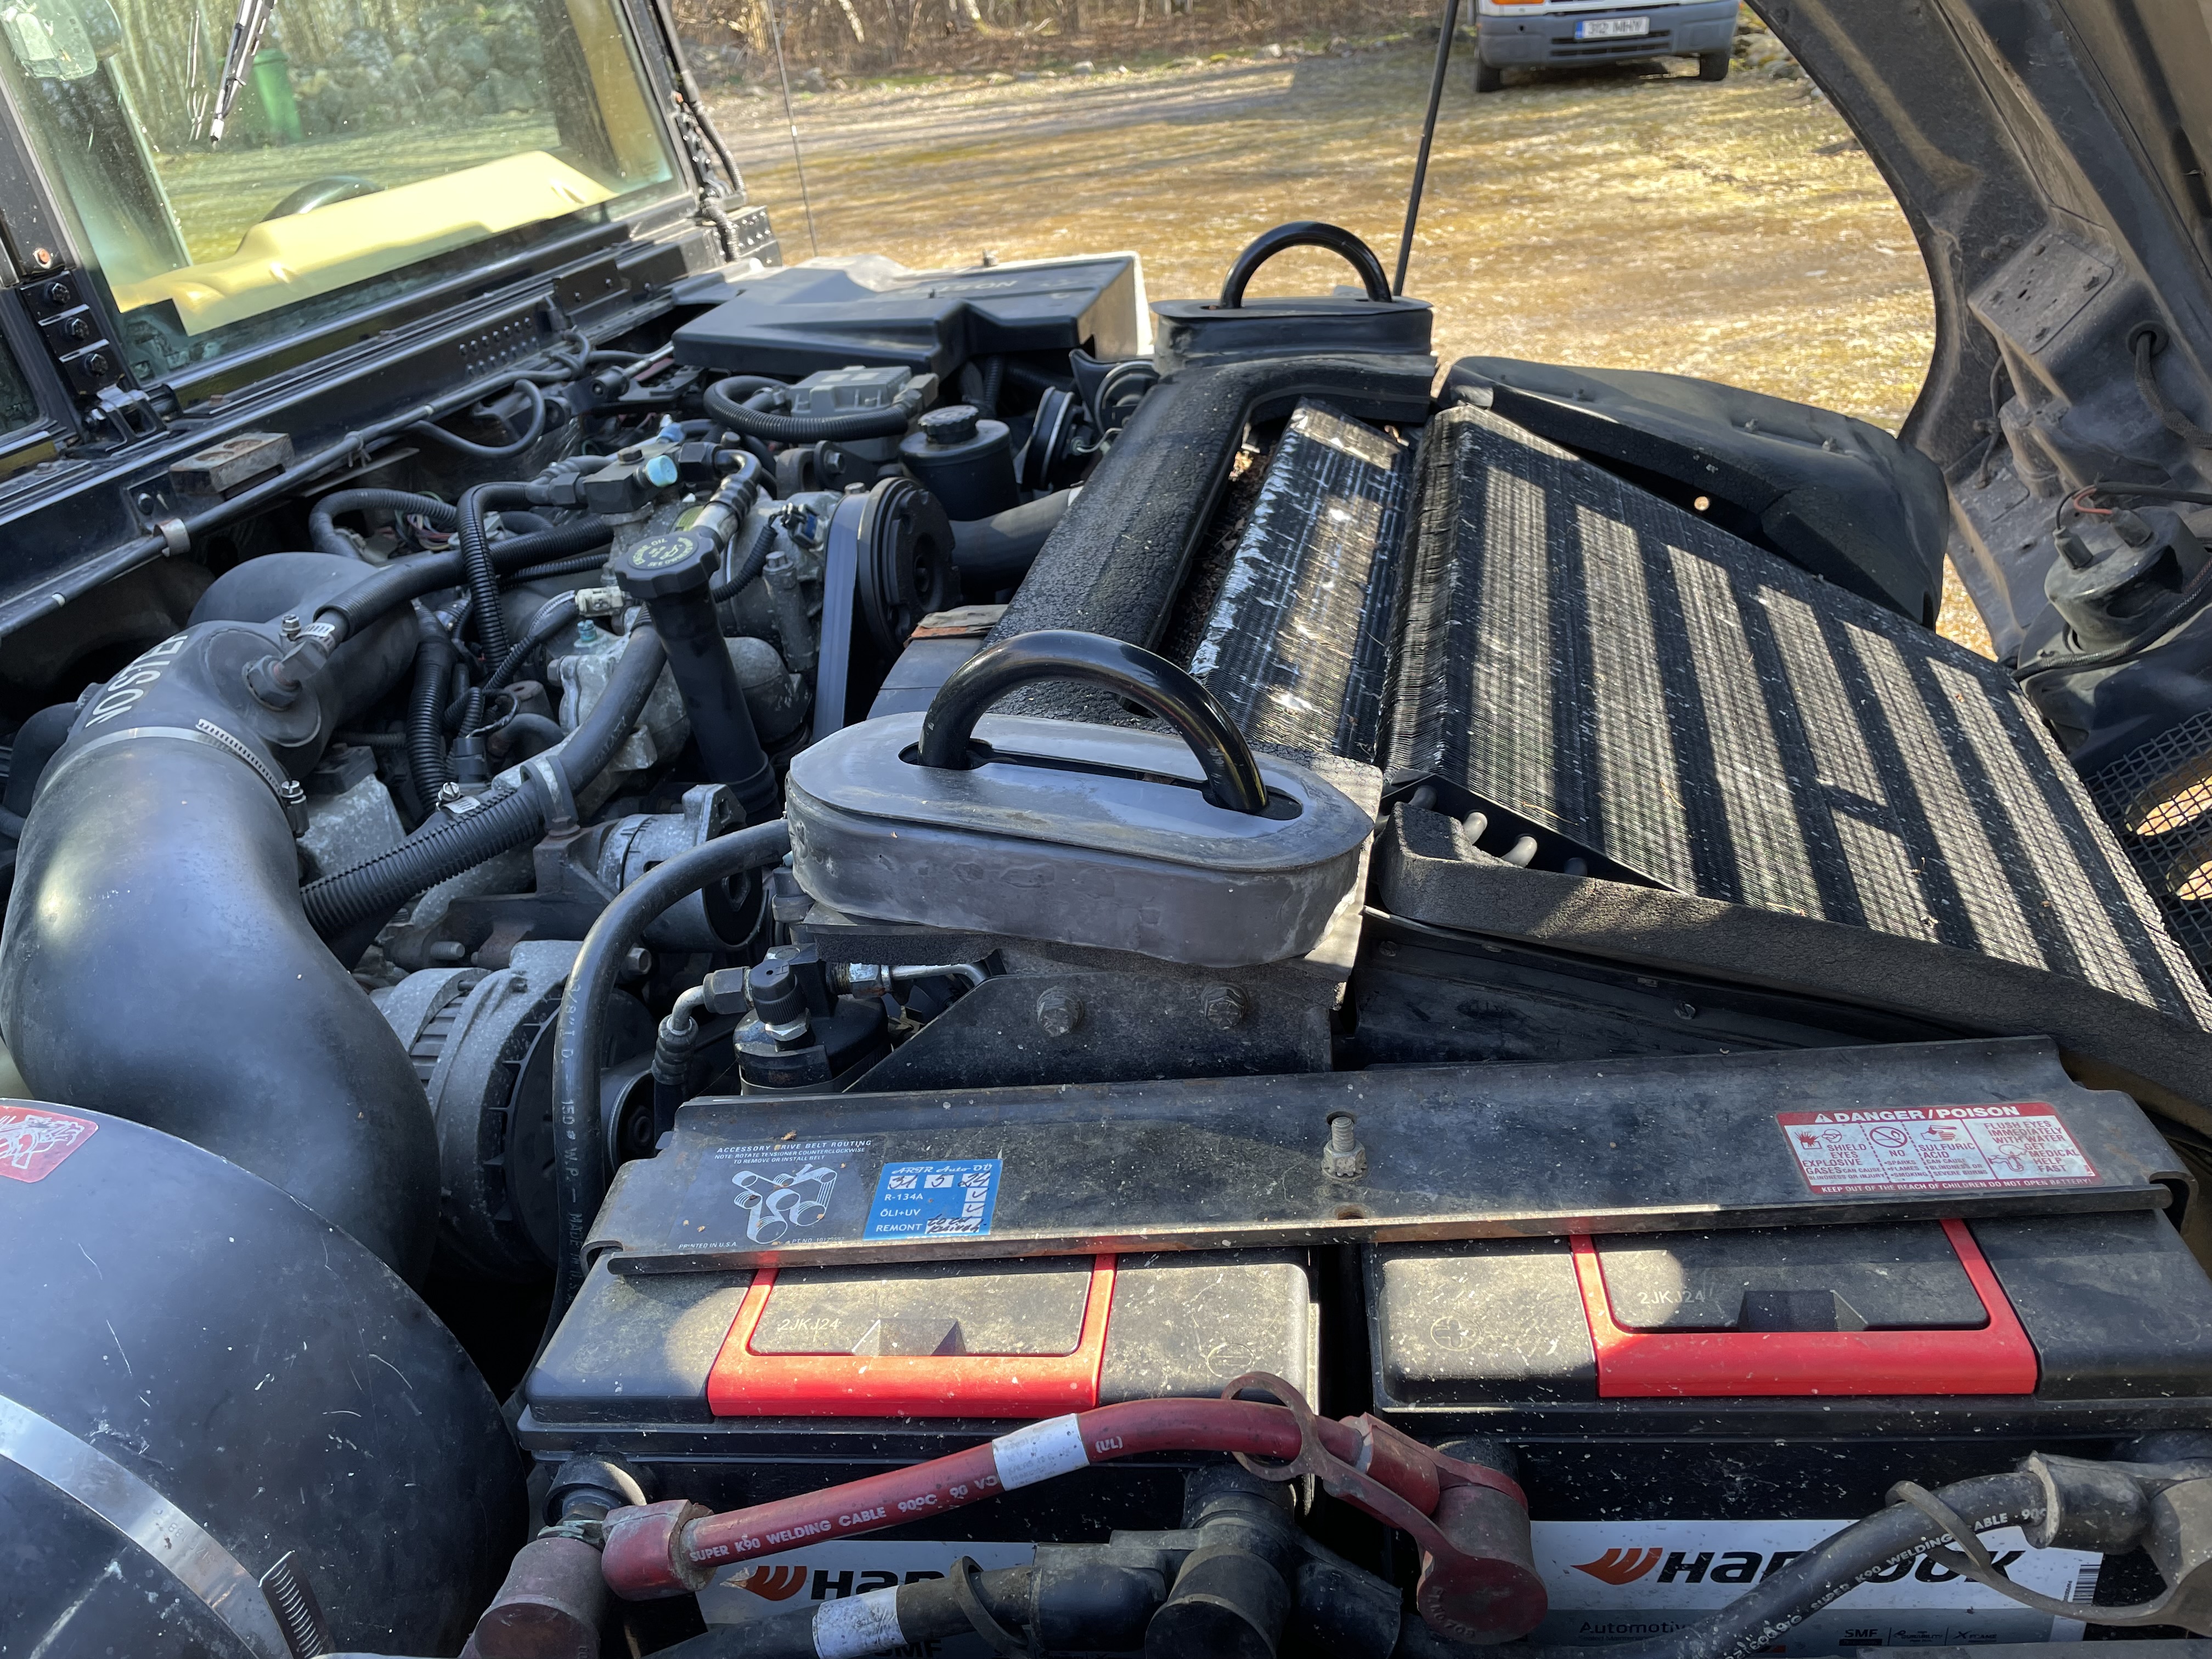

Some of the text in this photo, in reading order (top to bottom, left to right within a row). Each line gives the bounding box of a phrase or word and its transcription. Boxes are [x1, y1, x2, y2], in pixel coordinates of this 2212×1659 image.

[1984, 1121, 2022, 1130] FLUSH
[1988, 1128, 2062, 1137] IMMEDIATELY
[2025, 1135, 2066, 1143] WATER
[717, 1145, 771, 1153] ACCESSORY
[774, 1143, 801, 1151] RIVE
[798, 1148, 865, 1156] COUNTERCLOCKWISE
[1918, 1143, 1975, 1152] SULFURIC
[2029, 1149, 2080, 1158] MEDICAL
[1802, 1159, 1863, 1167] EXPLOSIVE
[562, 1098, 575, 1125] 150
[569, 1213, 583, 1248] MADE
[889, 1171, 990, 1189] 31 5 24
[1942, 1181, 1987, 1189] CHILDREN
[884, 1193, 923, 1201] R-134A
[880, 1209, 921, 1217] ÕLI+UV
[876, 1223, 923, 1232] REMONT
[1637, 1290, 1705, 1304] 2JKJ24
[1095, 1436, 1124, 1453] (UL)
[689, 1544, 730, 1562] SUPER
[734, 1536, 761, 1553] K90
[766, 1519, 832, 1545] WELDING
[838, 1506, 887, 1527] CABLE
[1811, 1582, 1852, 1611] SUPER
[1854, 1565, 1882, 1583] K90
[1886, 1533, 1954, 1566] WELDING
[1970, 1513, 2008, 1532] ABLE
[1844, 1629, 1878, 1638] SMF
